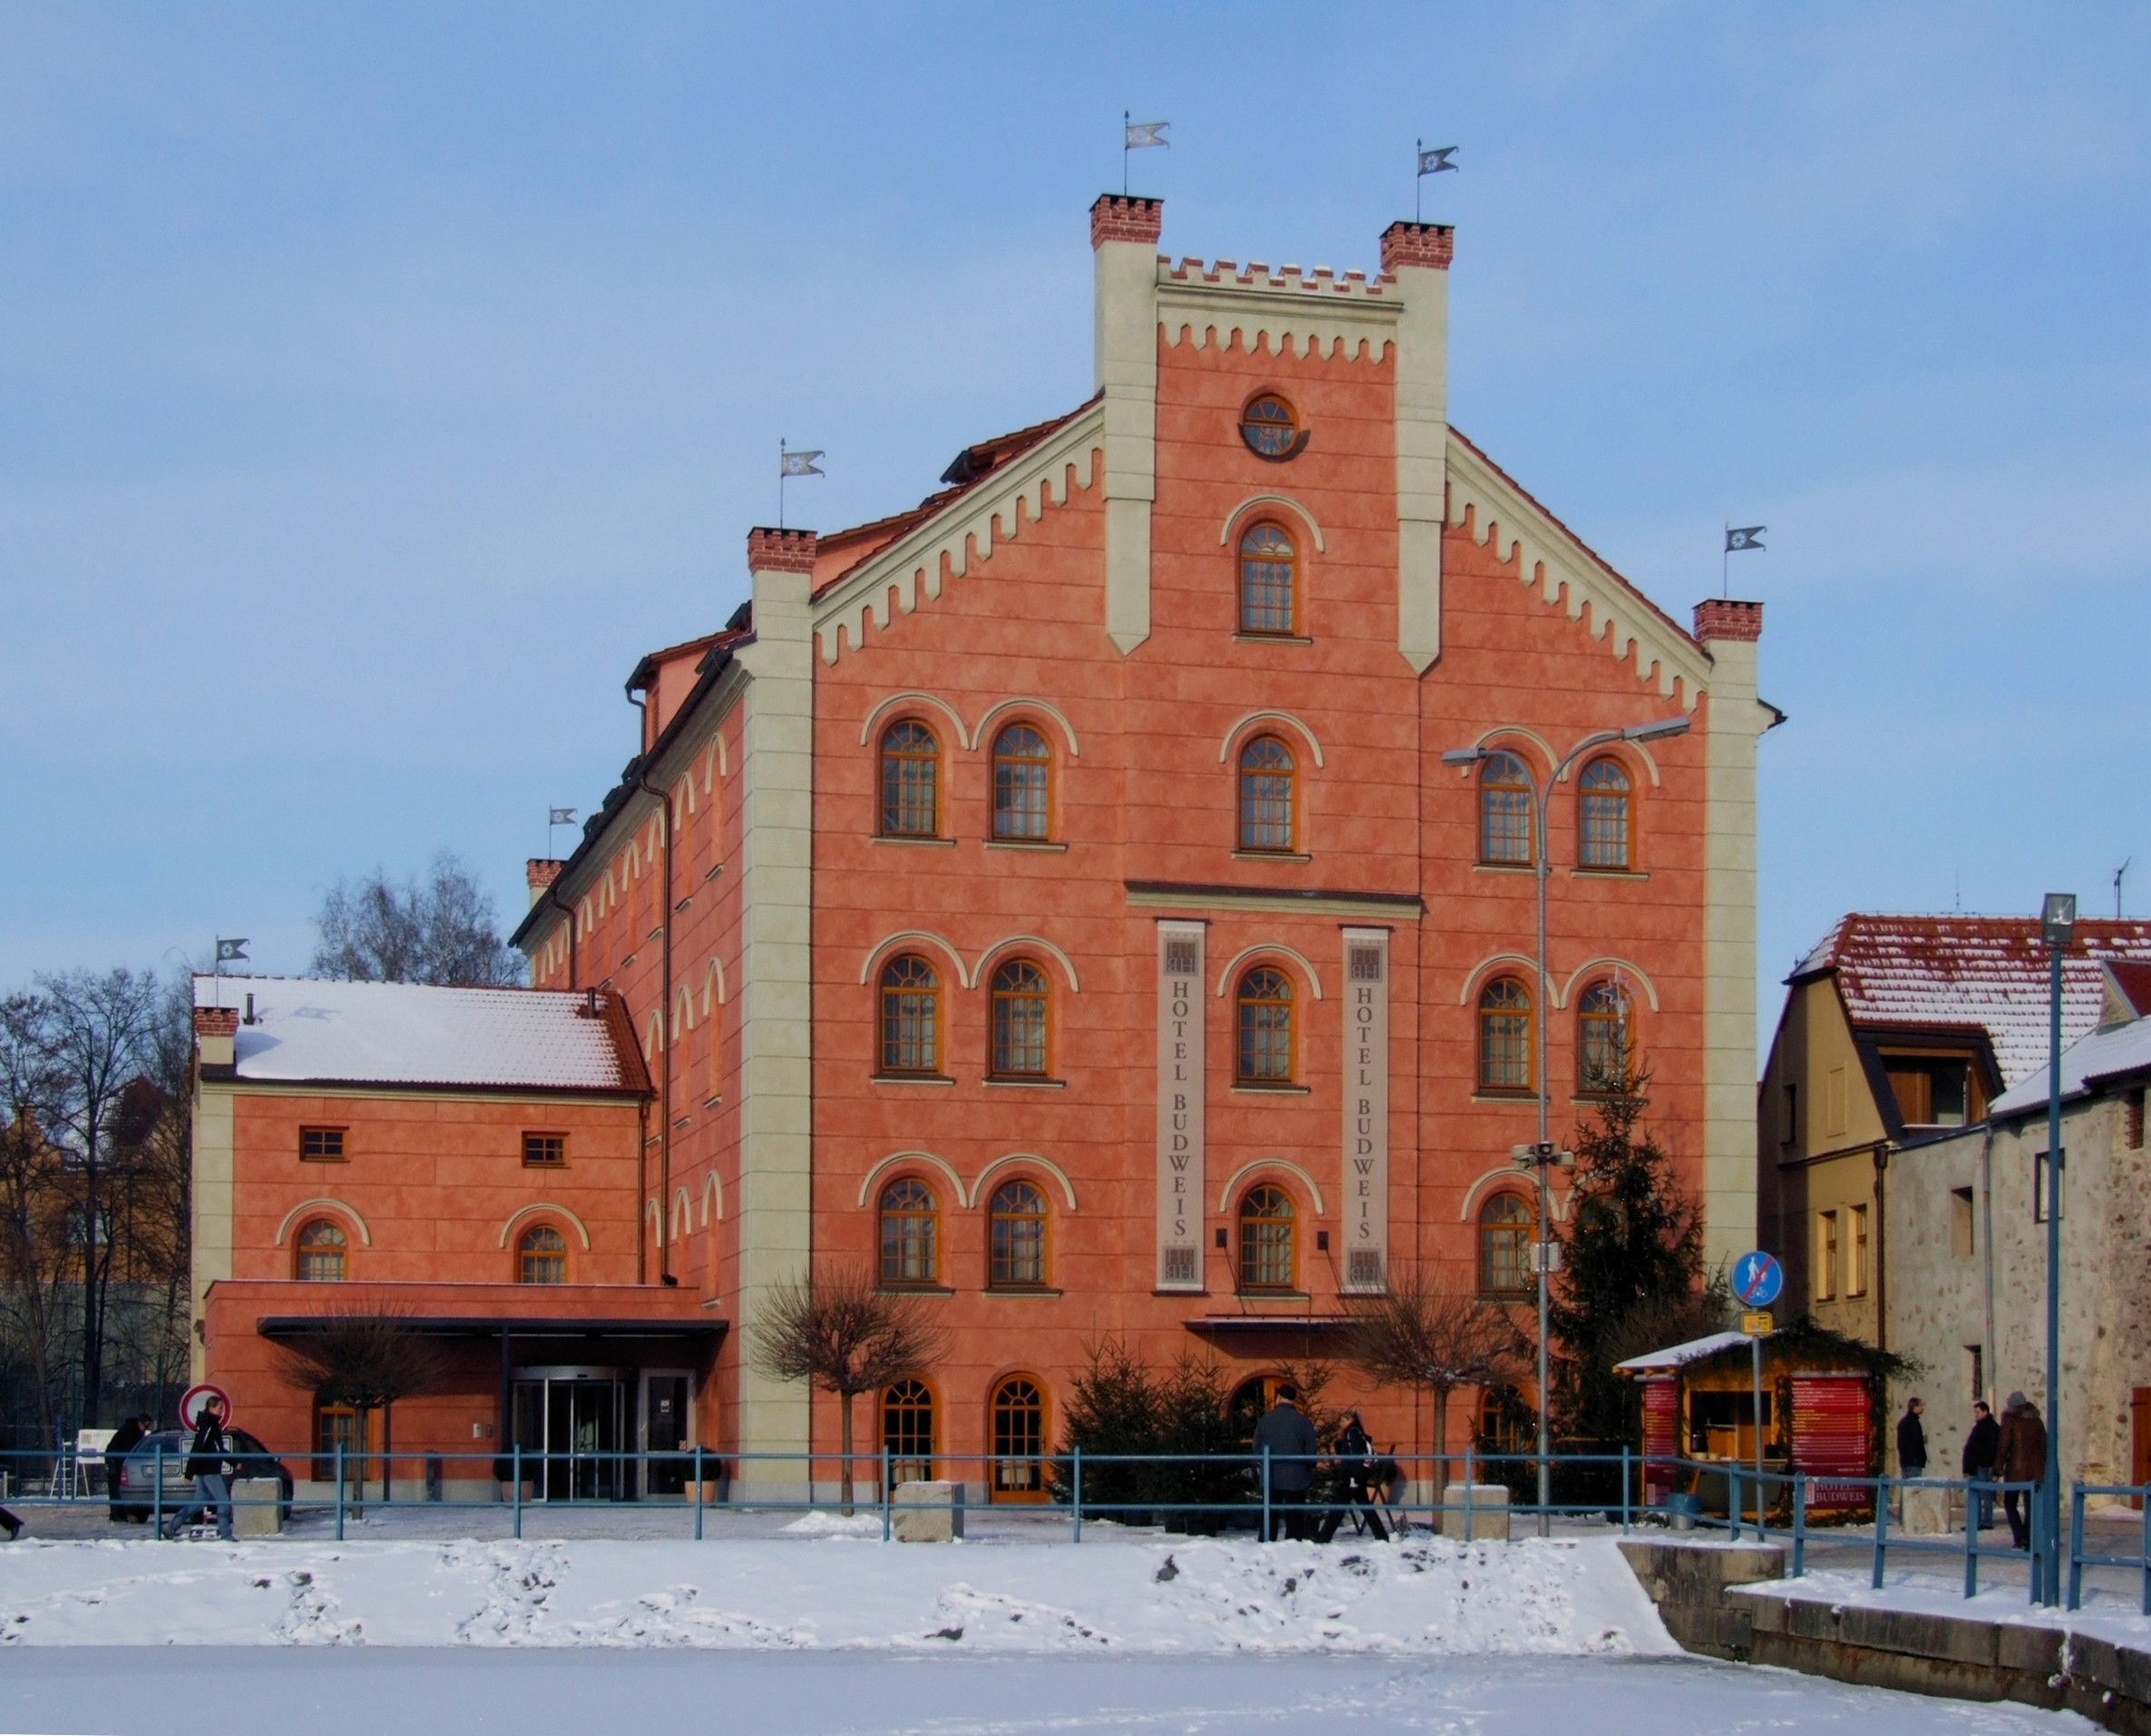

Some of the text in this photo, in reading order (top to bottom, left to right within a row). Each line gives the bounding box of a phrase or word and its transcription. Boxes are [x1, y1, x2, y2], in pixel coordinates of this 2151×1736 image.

[1168, 981, 1190, 1236] HOTEL BUDWEIS
[1353, 988, 1374, 1239] HOTEL BUDWEIS
[1816, 1491, 1865, 1502] BUDWEIS
